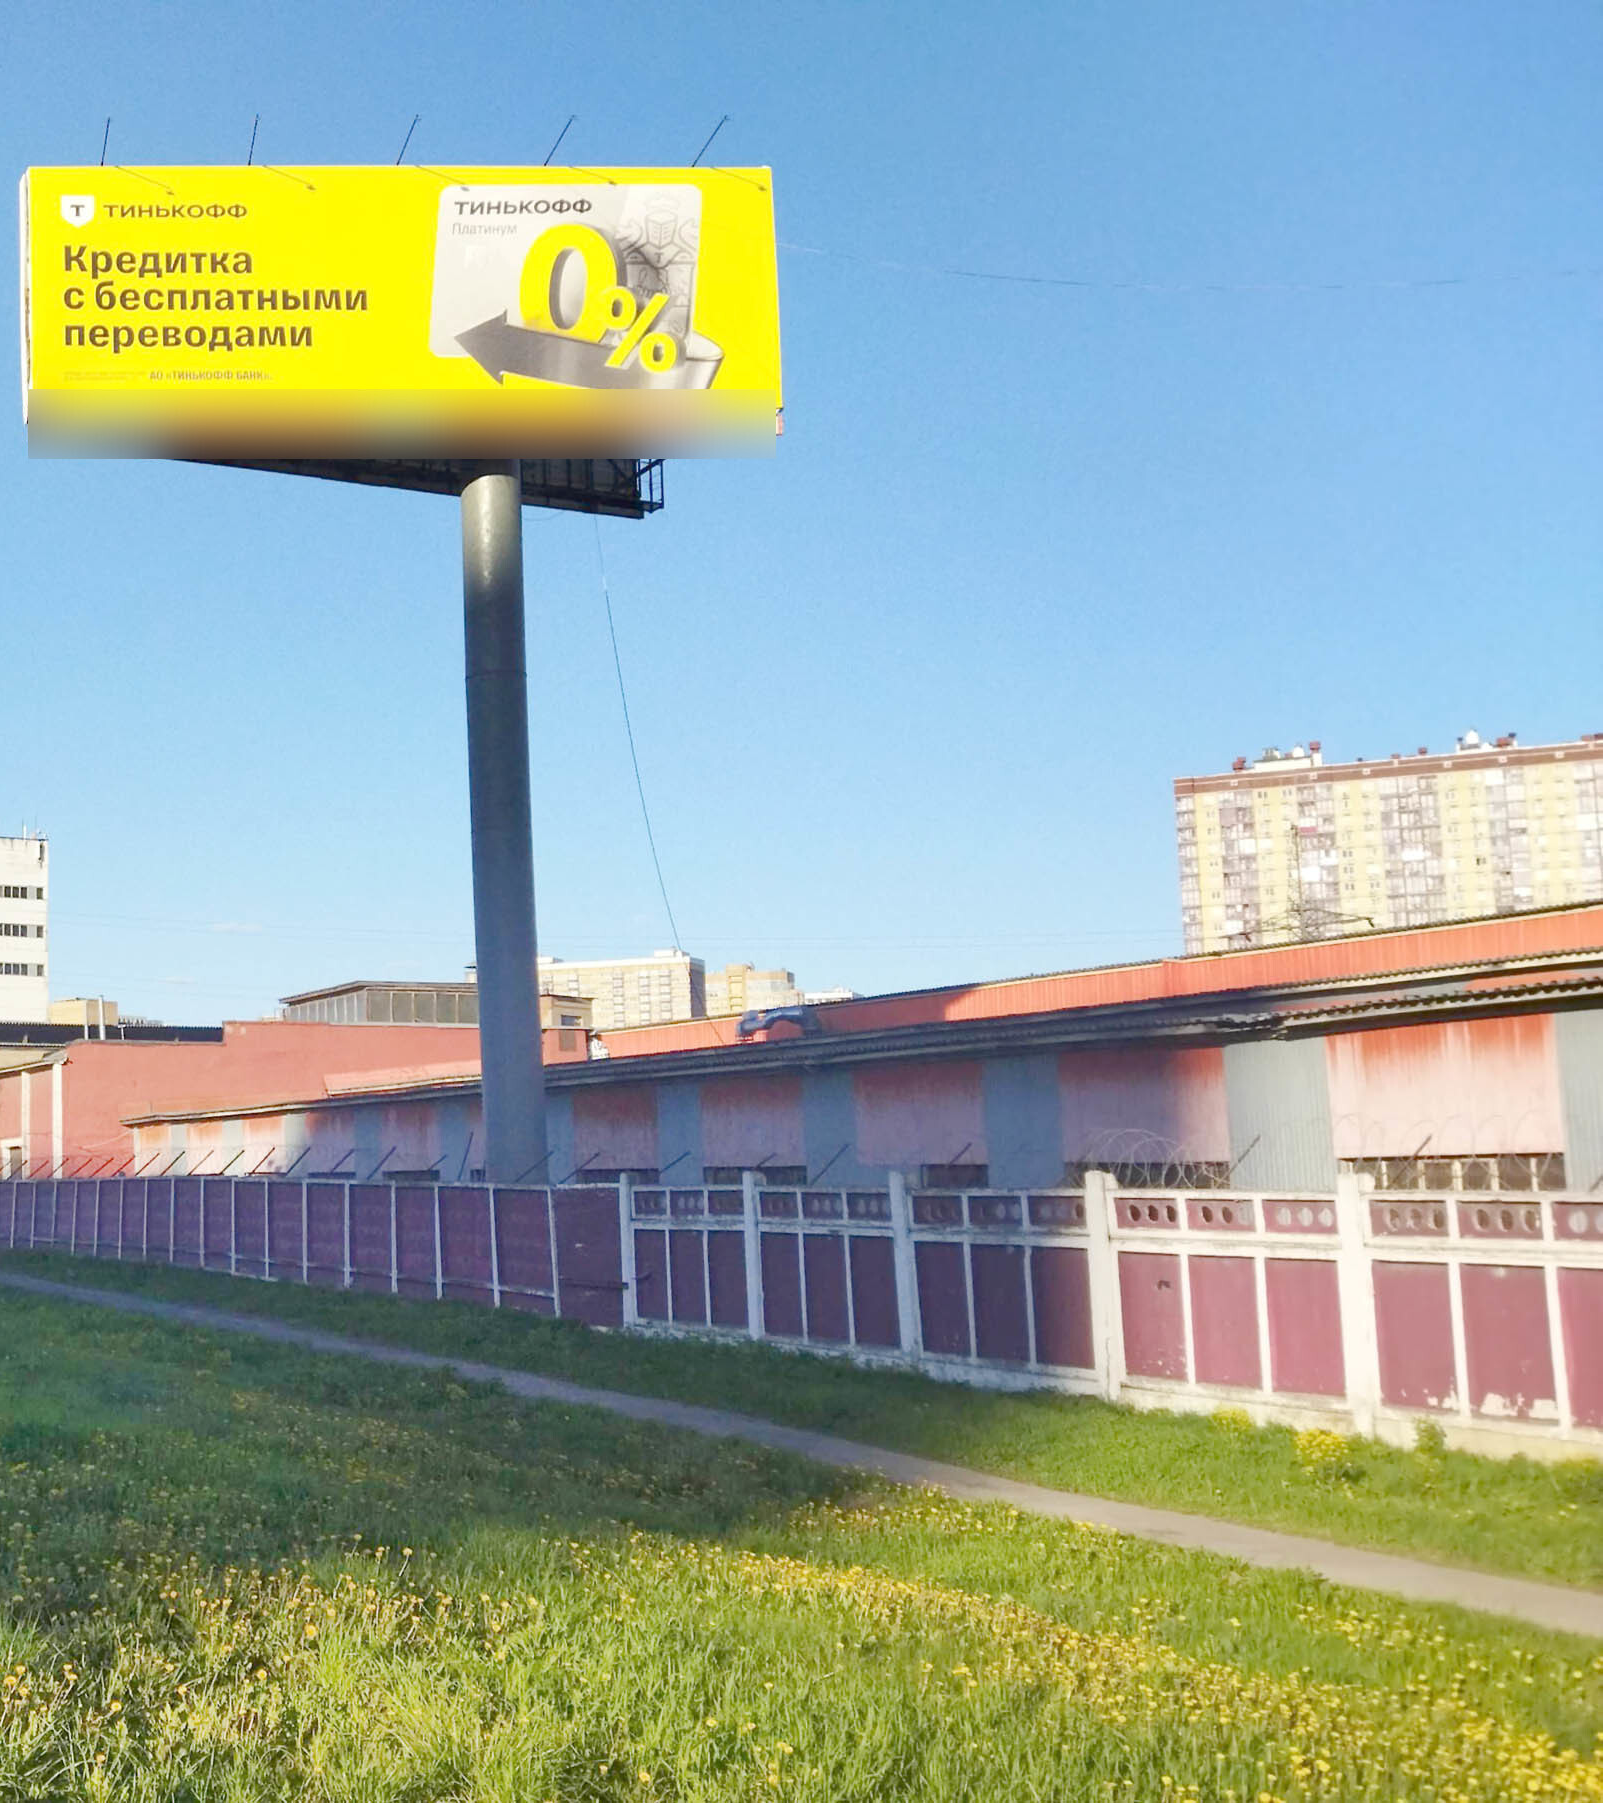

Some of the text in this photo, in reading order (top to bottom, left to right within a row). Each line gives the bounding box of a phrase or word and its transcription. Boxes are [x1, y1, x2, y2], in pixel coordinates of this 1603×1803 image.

[103, 203, 248, 219] ТИНЬКОФФ
[453, 198, 593, 216] ТИНЬКОФФ
[451, 221, 518, 237] Платинум
[63, 245, 253, 279] Кредитка
[63, 280, 368, 311] с бесплатными
[63, 323, 313, 354] переводами
